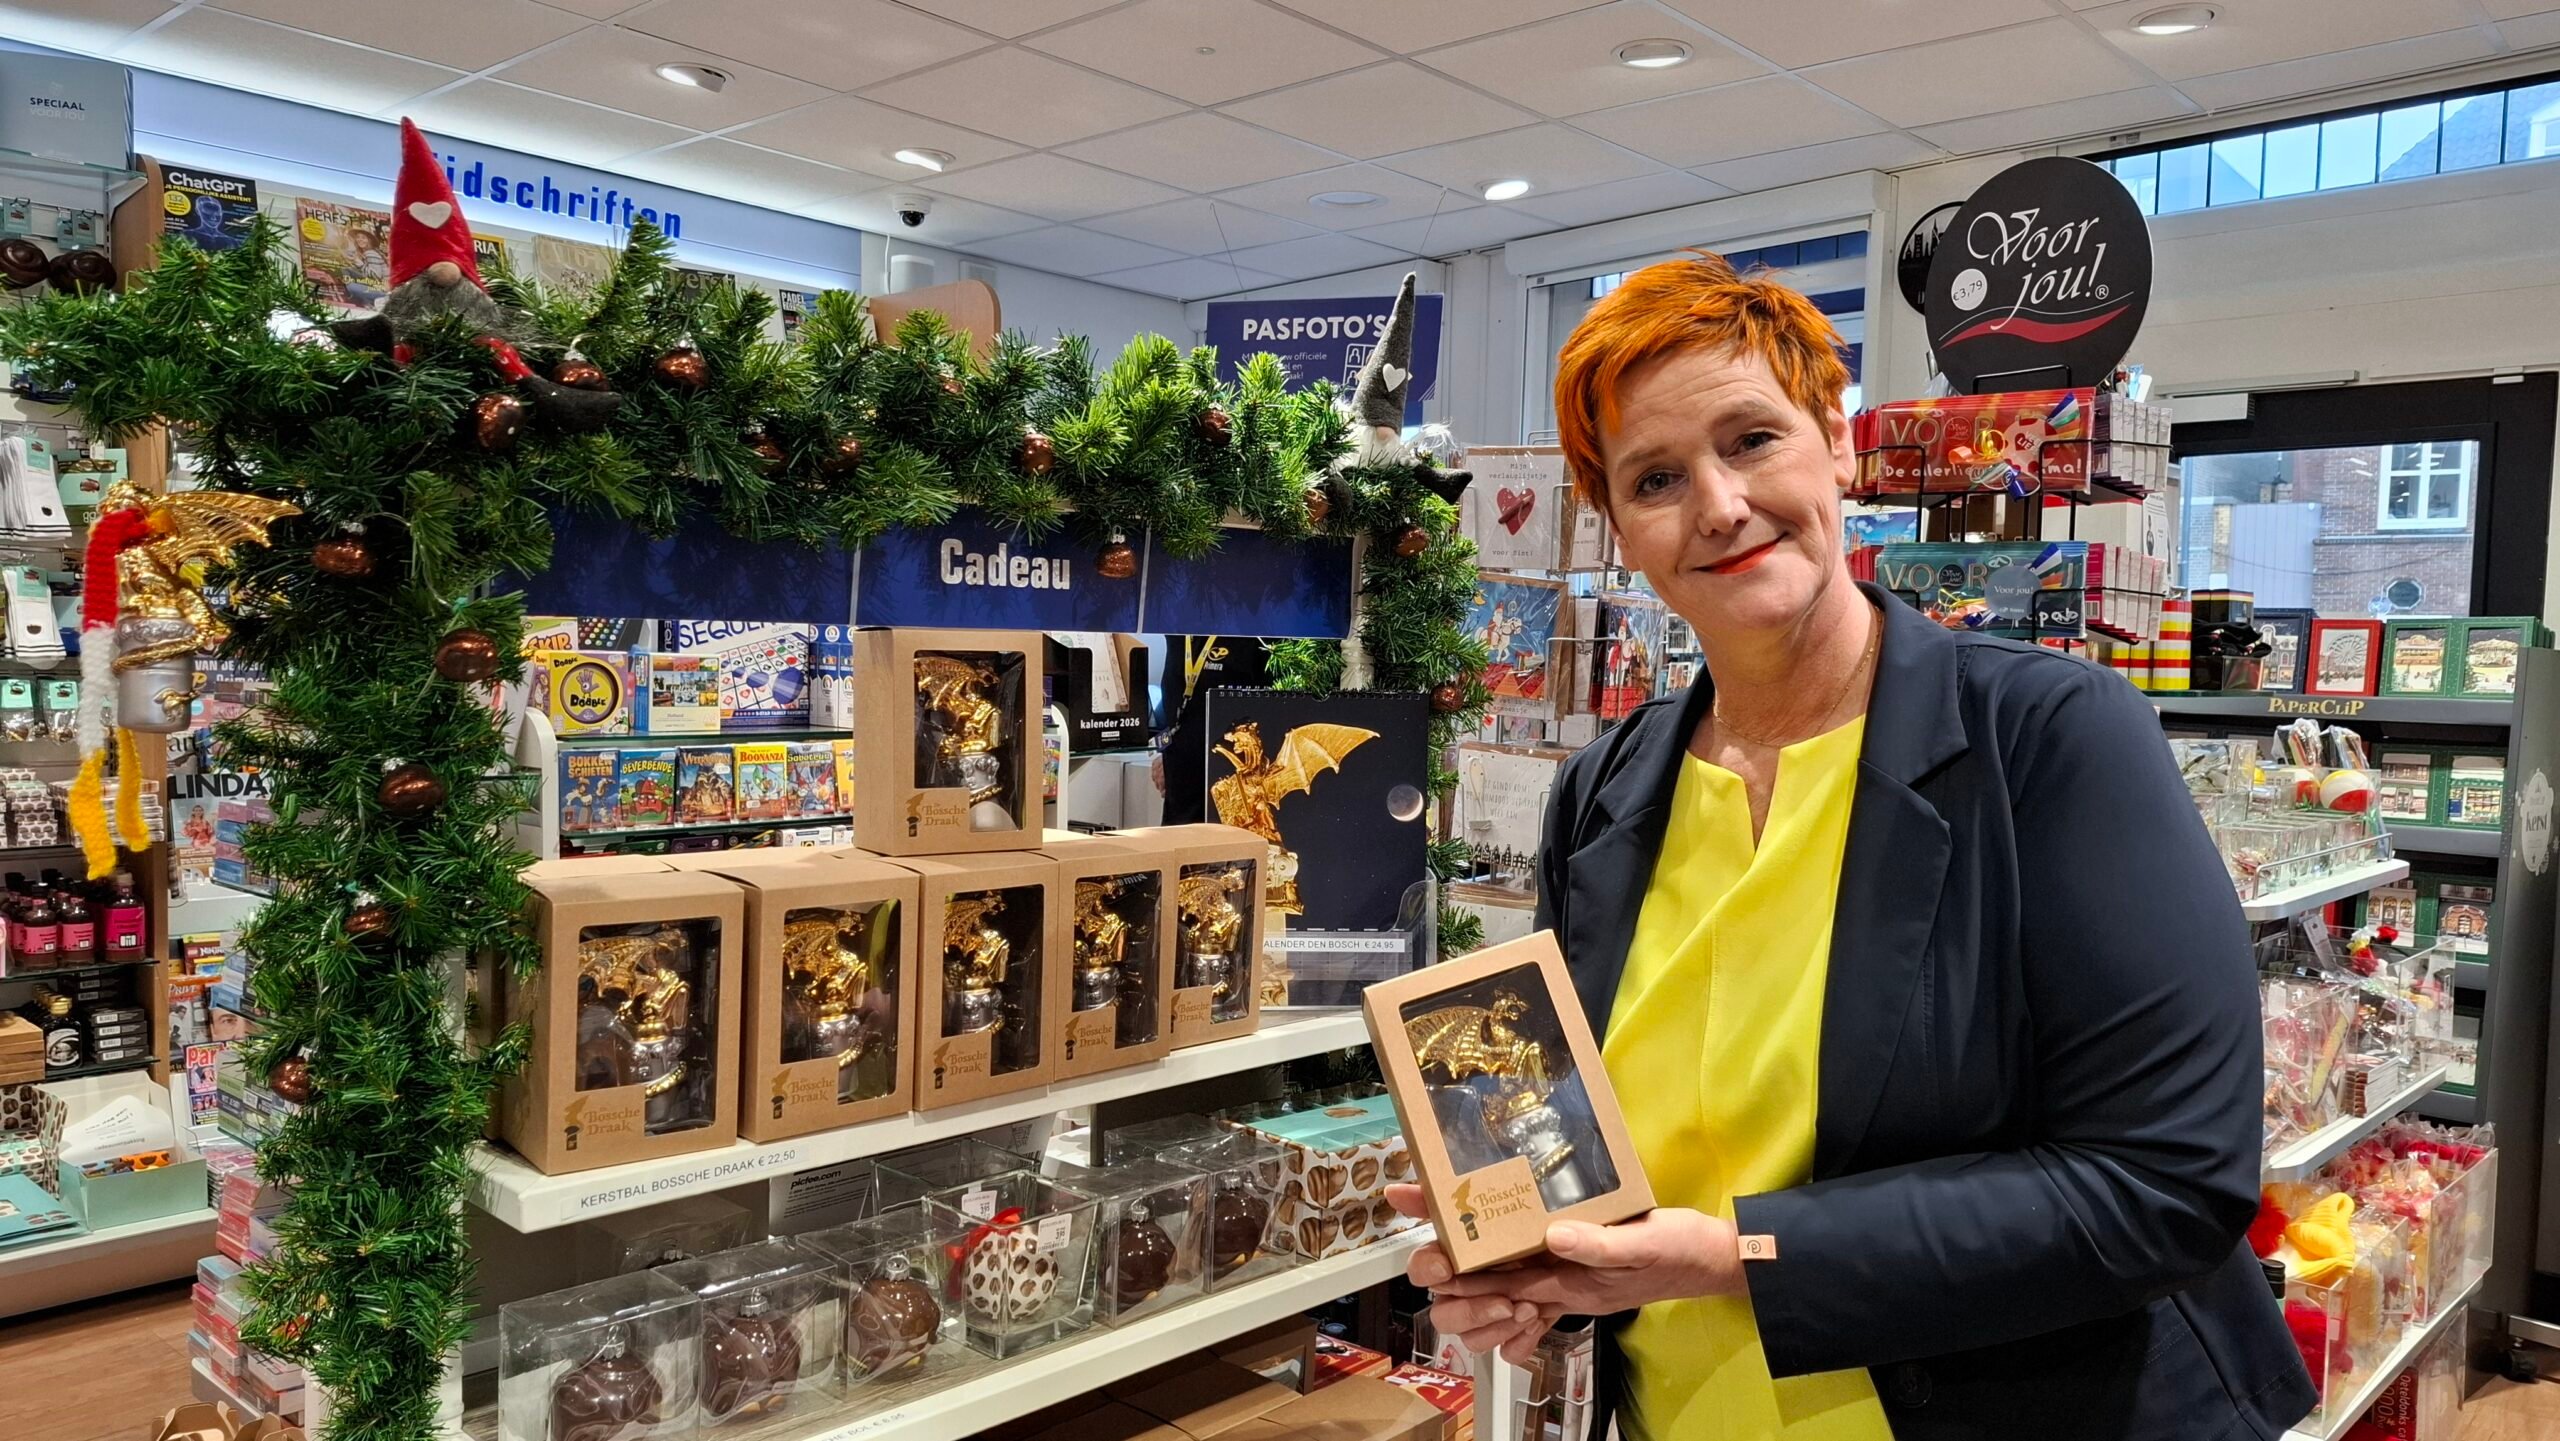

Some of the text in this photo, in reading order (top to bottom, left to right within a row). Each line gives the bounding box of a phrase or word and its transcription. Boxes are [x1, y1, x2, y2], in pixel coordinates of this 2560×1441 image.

[30, 97, 85, 111] SPECIAAL
[168, 171, 247, 197] ChatGPT
[1967, 207, 2099, 266] Voor
[473, 239, 499, 255] RIA
[1953, 279, 1983, 302] €3,79
[1243, 313, 1387, 341] PASFOTO'S
[1886, 464, 1905, 478] De
[940, 538, 1071, 590] Cadeau
[1994, 585, 2034, 596] Voor jou!
[194, 659, 218, 671] VAN
[1080, 717, 1140, 729] kalender 2026
[740, 751, 785, 762] BOONANZA
[568, 766, 613, 778] SCHIETEN
[622, 760, 673, 775] BEVERBENDE
[1263, 940, 1306, 949] ALENDER
[1307, 941, 1326, 949] DEN
[1328, 941, 1360, 949] BOSCH
[187, 1043, 226, 1067] Par
[583, 1106, 641, 1123] Bossche
[586, 1120, 634, 1136] Draak
[580, 1149, 796, 1209] KERSTBAL BOSSCHE DRAAK € 22,50
[790, 1170, 842, 1190] picfee.com
[1473, 1182, 1533, 1208] Bossche
[1482, 1197, 1533, 1222] Draak
